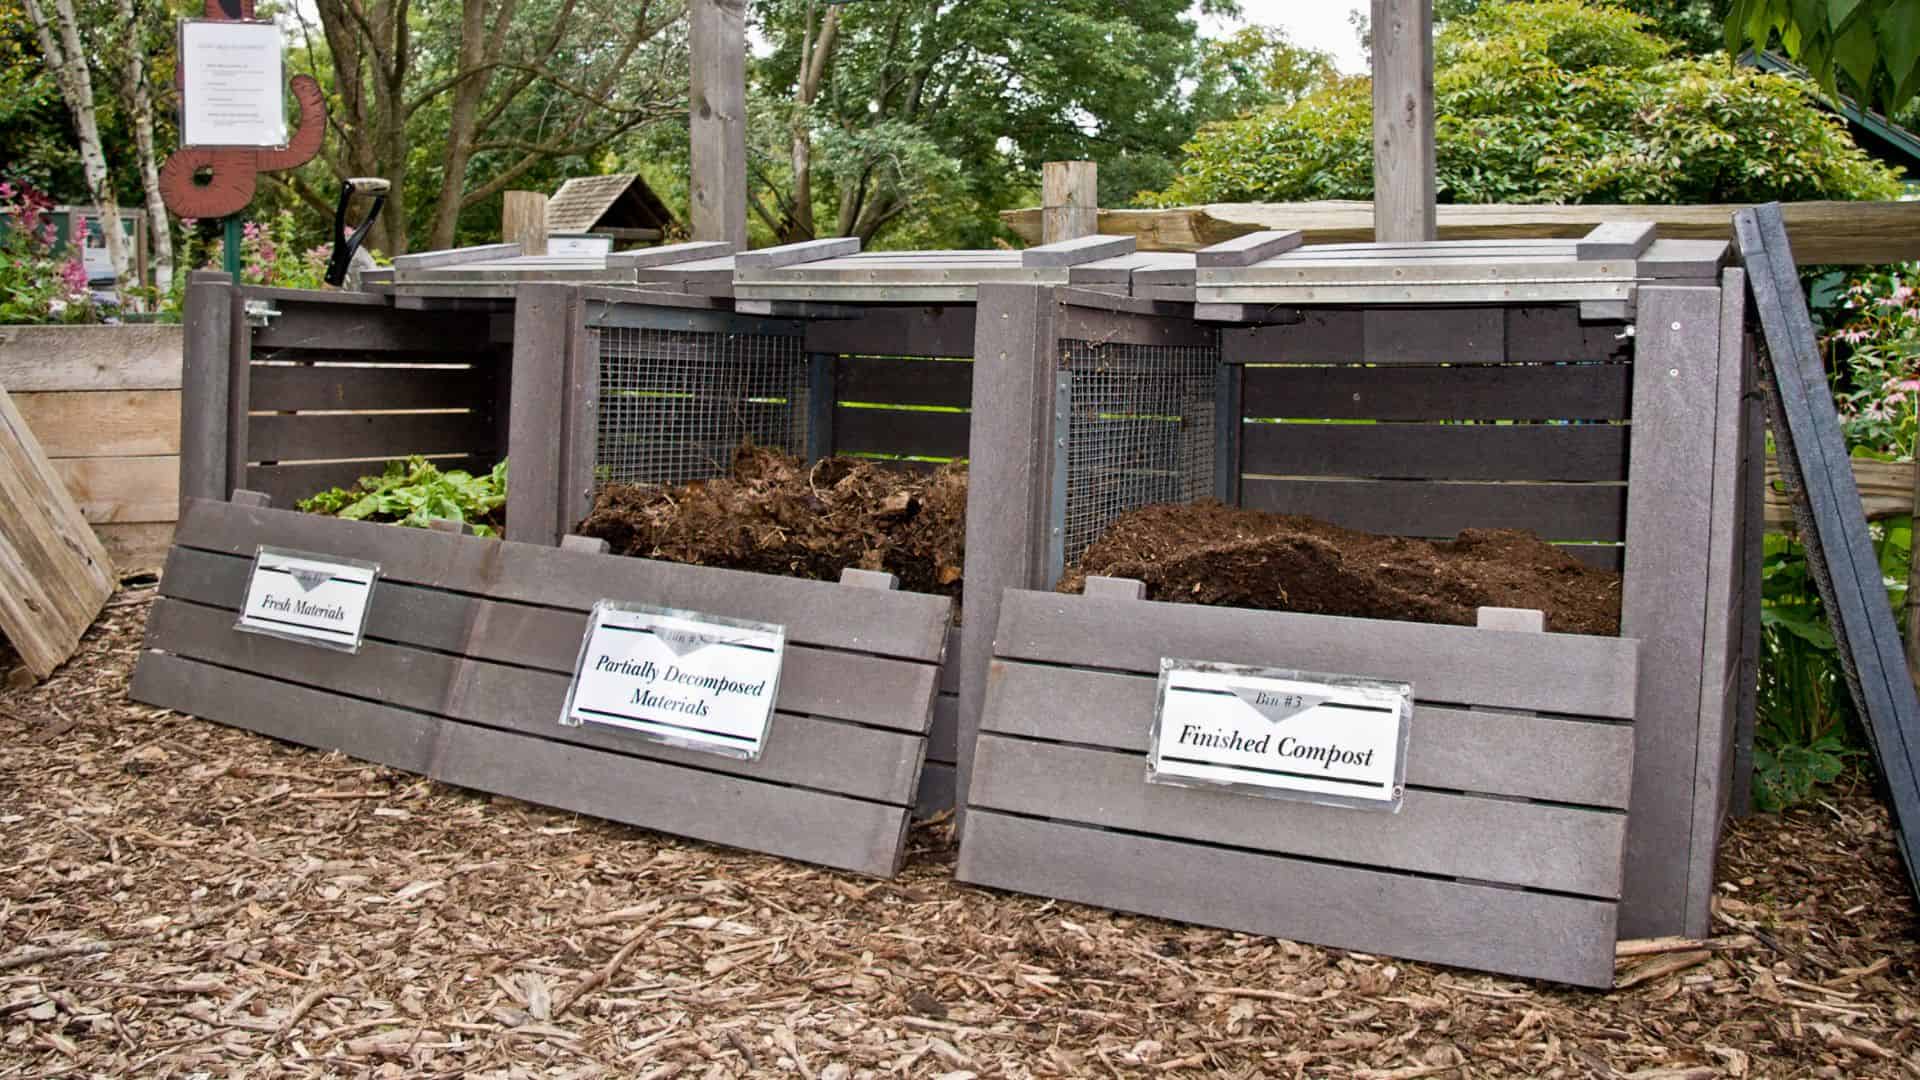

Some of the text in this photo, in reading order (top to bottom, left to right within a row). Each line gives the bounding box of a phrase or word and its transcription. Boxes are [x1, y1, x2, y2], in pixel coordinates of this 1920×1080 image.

[261, 594, 345, 621] Fresh Materials
[595, 655, 766, 698] Partially Decomposed
[630, 687, 711, 717] Materials
[1255, 691, 1279, 706] Bin
[1178, 723, 1375, 769] Finished Compost
